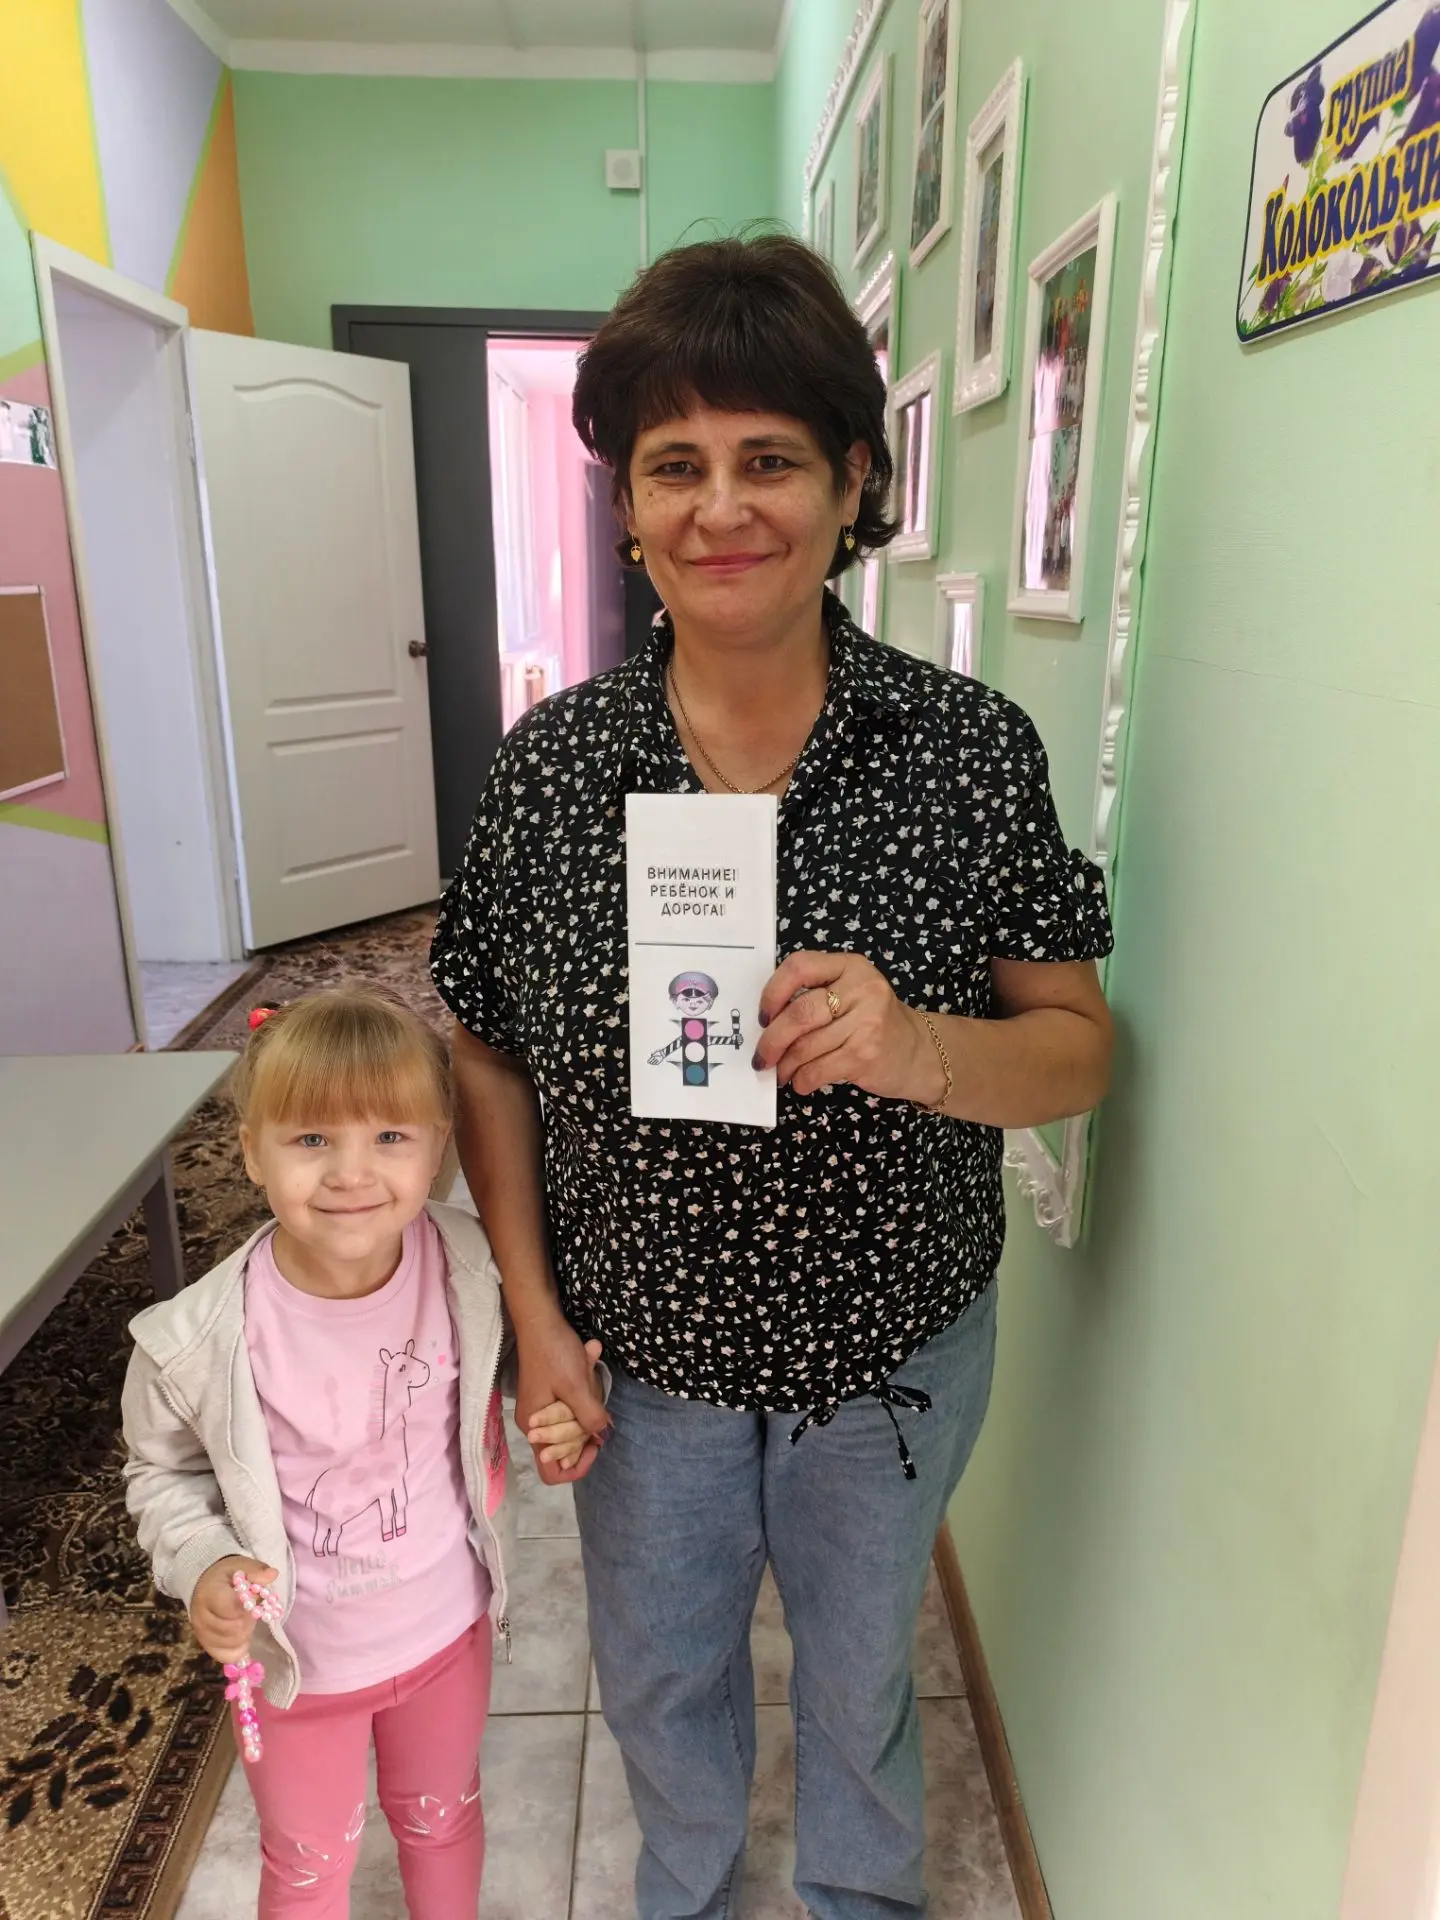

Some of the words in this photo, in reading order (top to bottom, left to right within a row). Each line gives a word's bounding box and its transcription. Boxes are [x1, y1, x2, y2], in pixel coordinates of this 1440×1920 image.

[647, 866, 737, 882] ВНИМАНИЕ!
[650, 882, 719, 899] РЕБЁНОК
[725, 886, 735, 899] И
[661, 902, 724, 917] ДОРОГА!
